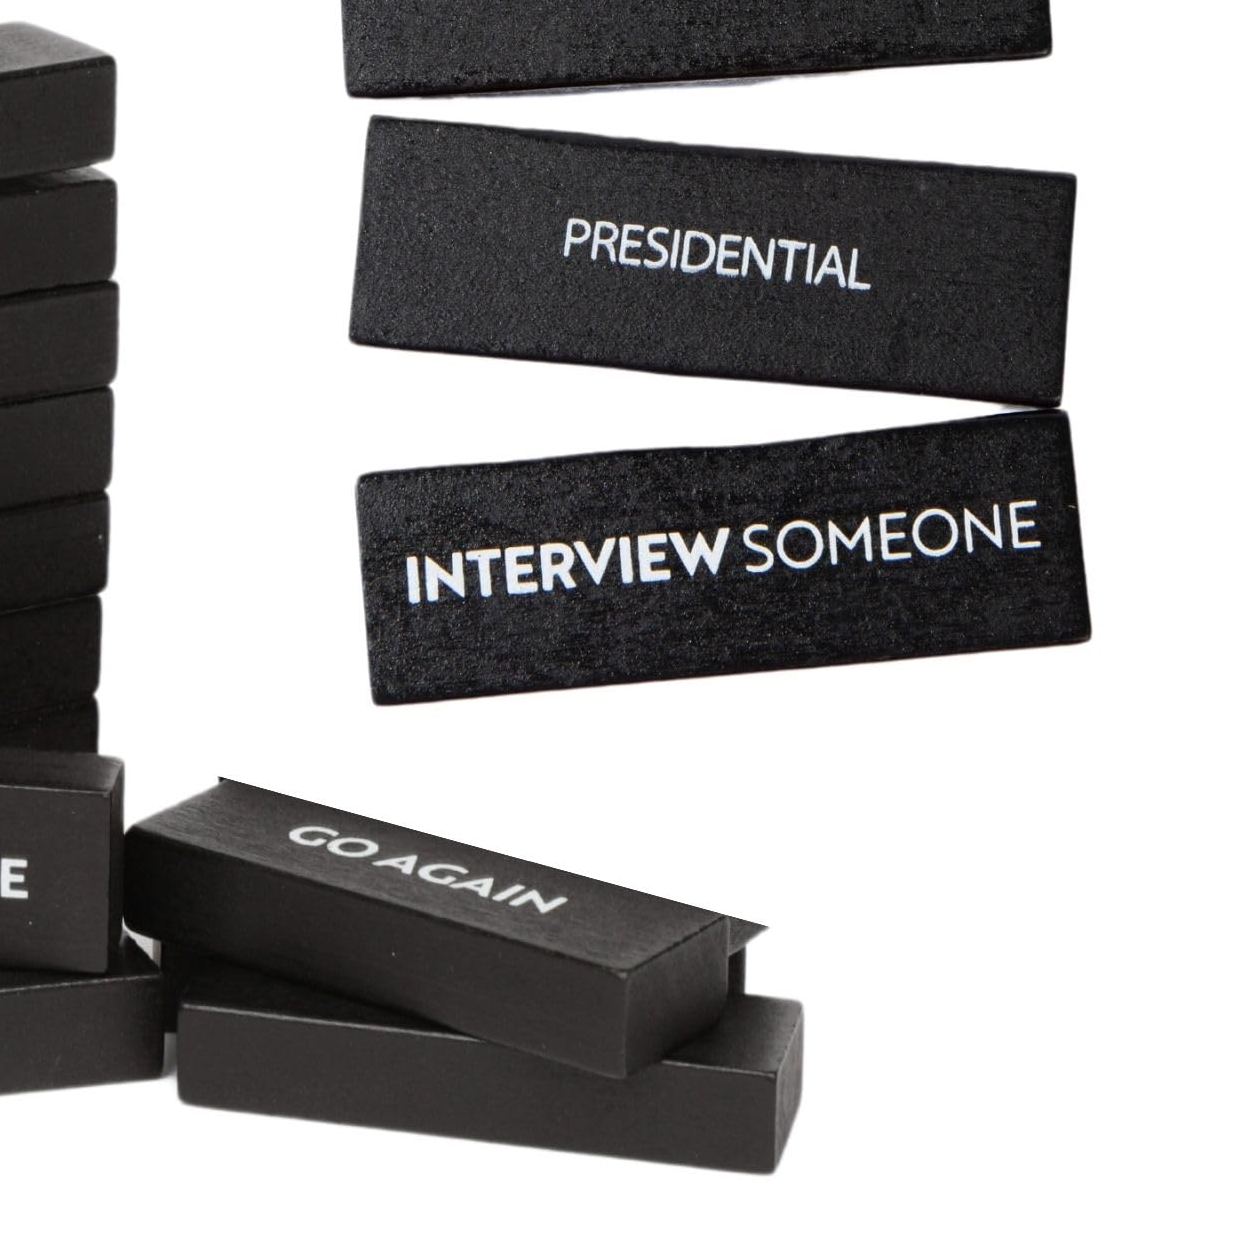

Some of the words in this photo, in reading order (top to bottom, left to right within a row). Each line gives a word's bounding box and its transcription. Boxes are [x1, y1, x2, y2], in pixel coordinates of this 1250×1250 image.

[563, 217, 872, 291] PRESIDENTIAL
[406, 527, 730, 605] INTERVIEW
[742, 500, 1042, 573] SOMEONE
[288, 825, 379, 858] GO
[371, 854, 568, 914] AGAIN
